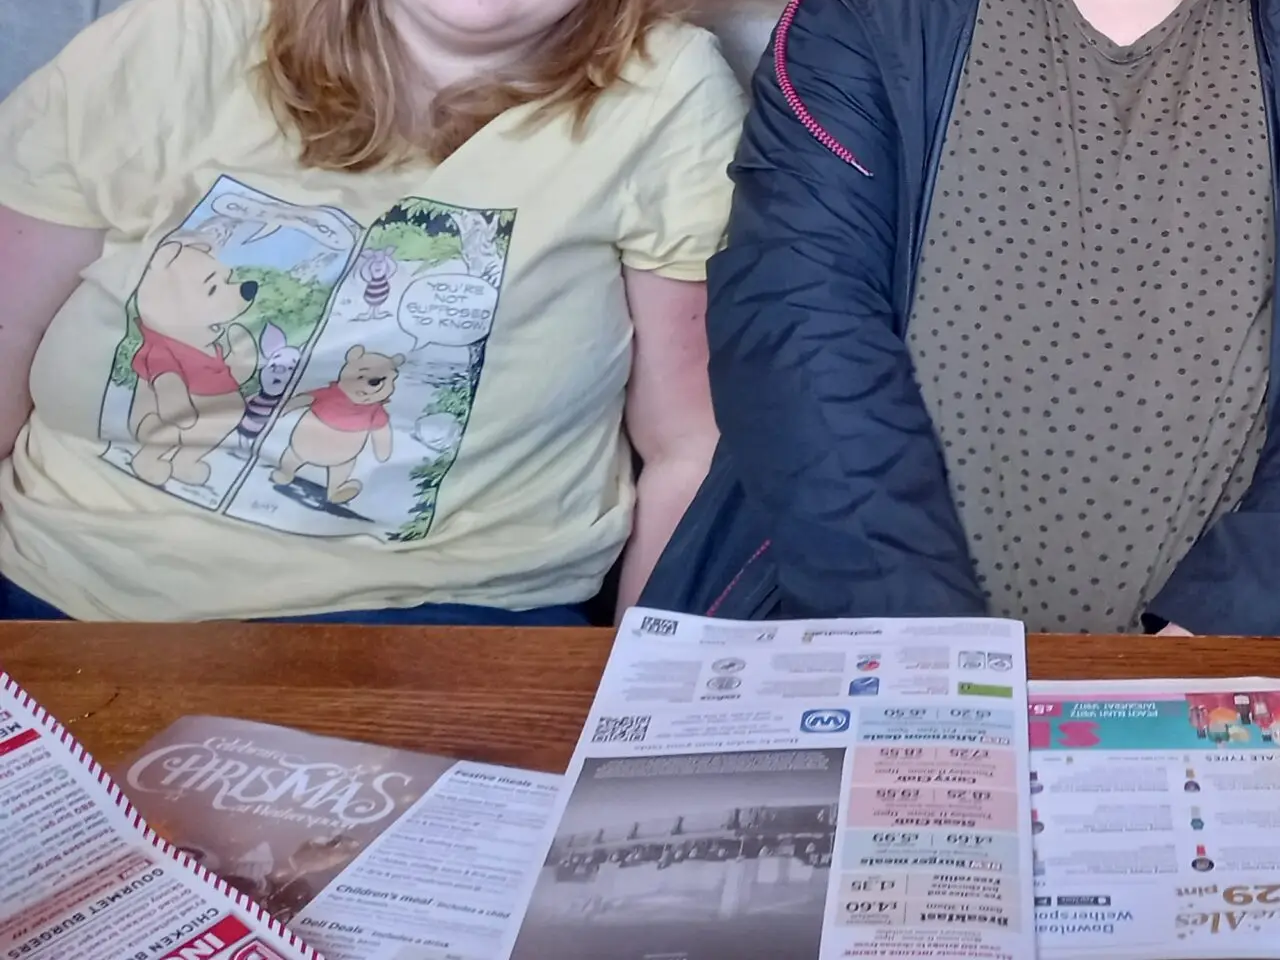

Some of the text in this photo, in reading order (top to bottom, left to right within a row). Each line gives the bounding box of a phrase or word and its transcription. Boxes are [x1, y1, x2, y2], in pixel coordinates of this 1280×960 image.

[427, 281, 484, 295] YOU'RE
[434, 293, 468, 303] NOT
[406, 302, 490, 319] SUPPOSED
[412, 315, 433, 325] TO
[863, 734, 902, 742] deals
[904, 734, 977, 742] Afternoon
[896, 774, 976, 784] Curry Club
[934, 818, 976, 827] Steak
[912, 857, 965, 866] Burger
[88, 868, 164, 915] GOURMET
[336, 884, 397, 900] Children's
[400, 895, 433, 905] meal
[1176, 884, 1218, 898] pint
[846, 901, 897, 913] £4.60
[301, 917, 327, 928] Deli
[328, 922, 364, 934] Deals
[920, 913, 1008, 927] Breakfast
[1175, 908, 1247, 934] Ales
[7, 913, 86, 959] BURGERS
[148, 908, 220, 953] CHICKEN
